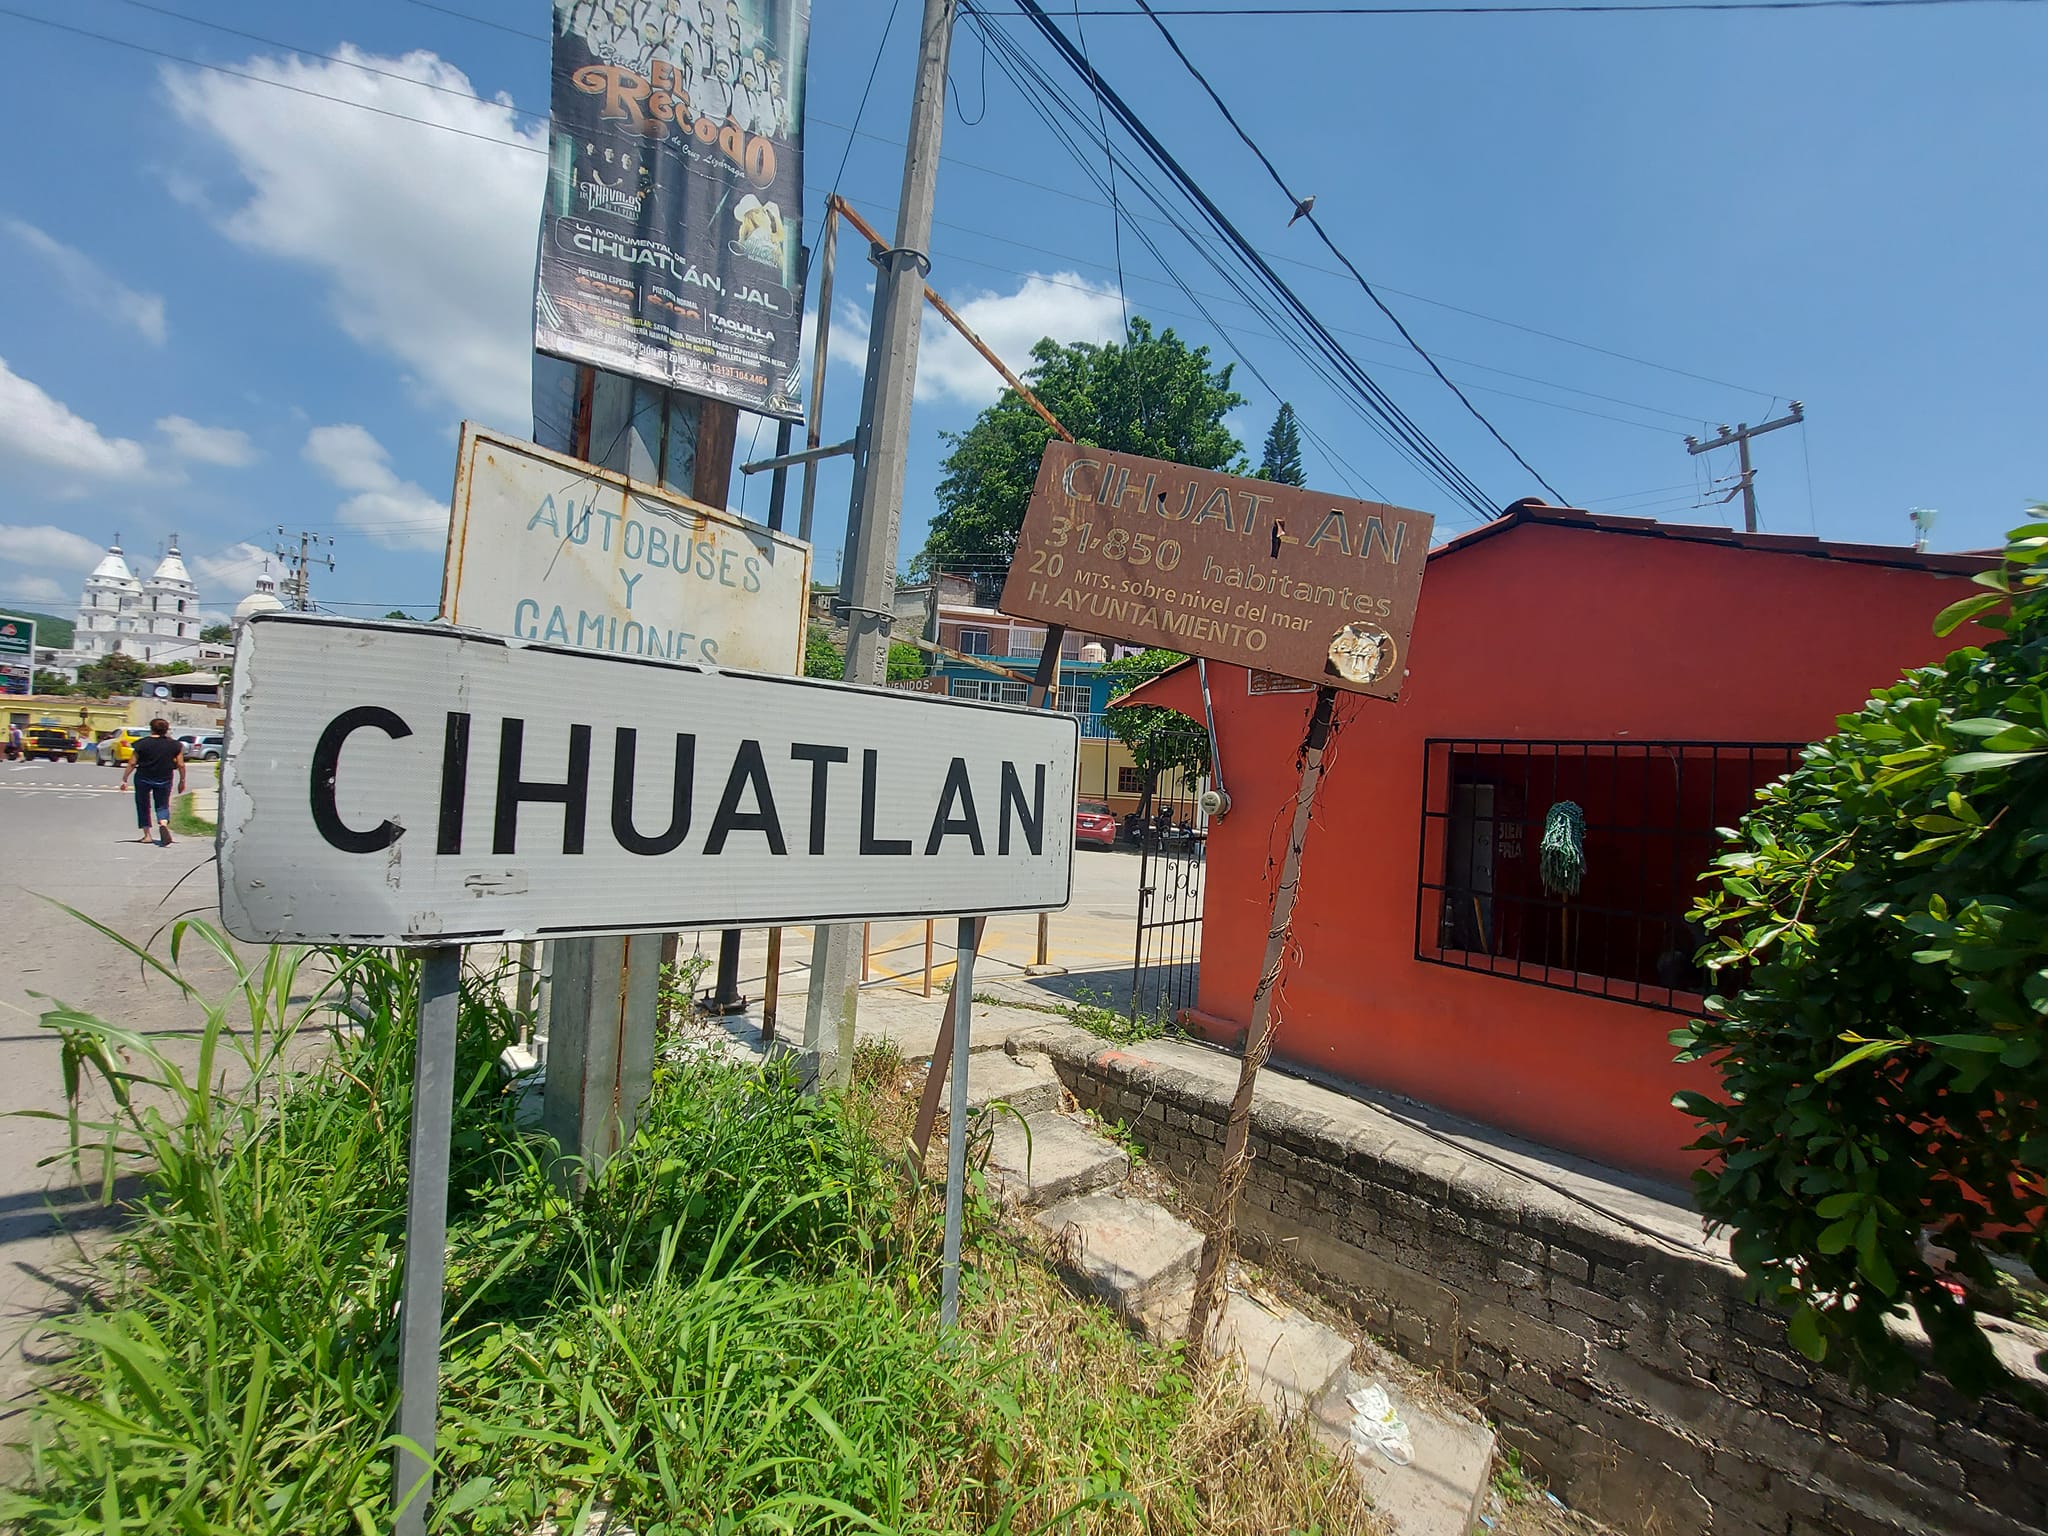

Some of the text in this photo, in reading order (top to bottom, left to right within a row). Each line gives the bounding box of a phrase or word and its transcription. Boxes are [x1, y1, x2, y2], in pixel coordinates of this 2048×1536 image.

[671, 136, 681, 147] de
[682, 143, 701, 161] Cruz
[576, 222, 687, 265] LA MONUMENTAL DE
[709, 313, 776, 342] TAQUILLA
[733, 285, 779, 311] JAL
[527, 493, 761, 593] AUTOBUSES
[1061, 458, 1409, 566] CIHUATLAN
[618, 567, 644, 610] Y
[1027, 581, 1268, 653] H. AYUNTAMIENTO
[1028, 550, 1313, 634] 20 MTS. sobre nivel del mar
[1203, 555, 1393, 619] habitantes
[309, 705, 1046, 857] CIHUATLAN
